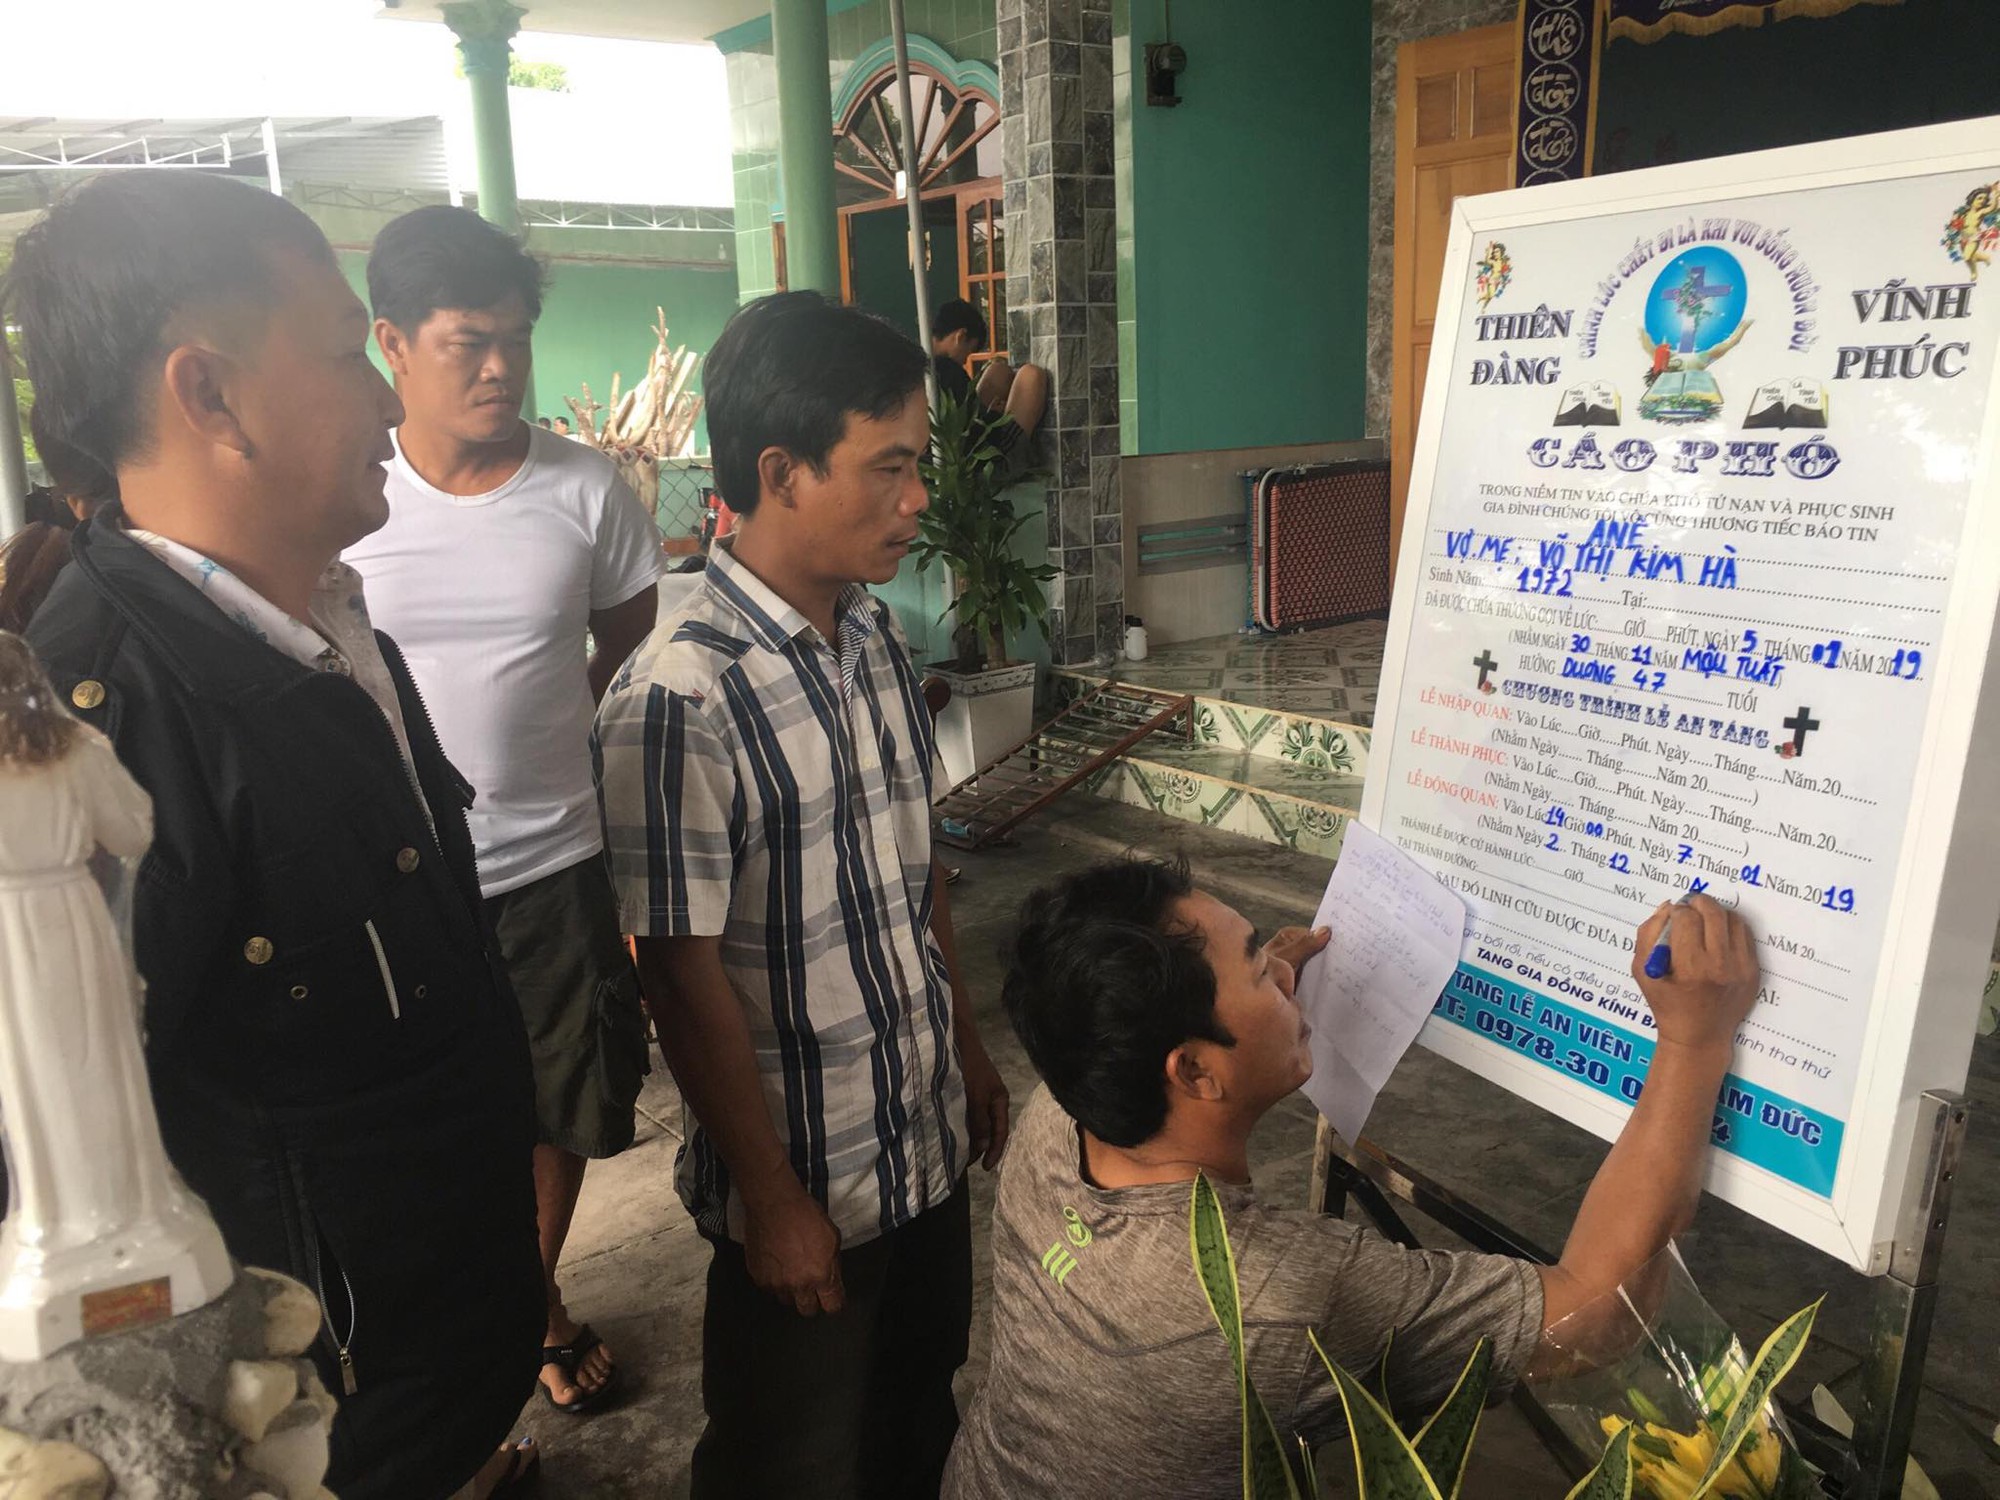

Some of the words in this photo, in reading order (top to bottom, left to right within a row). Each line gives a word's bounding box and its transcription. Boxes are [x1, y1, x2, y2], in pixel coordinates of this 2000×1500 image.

[1700, 218, 1731, 240] KHI
[1732, 218, 1761, 247] VUI
[1475, 303, 1575, 341] THIÊN
[1851, 277, 1977, 323] VĨNH
[1470, 350, 1561, 386] ĐÀNG
[1832, 333, 1970, 380] PHÚC
[1527, 432, 1658, 473] CÁO
[1671, 435, 1841, 480] PHÓ
[1479, 484, 1522, 498] TRONG
[1560, 488, 1584, 501] TIN
[1729, 498, 1765, 515] NẠN
[1770, 498, 1793, 514] VÀ
[1798, 501, 1846, 520] PHỤC
[1850, 504, 1895, 521] SINH
[1483, 501, 1506, 514] GIA
[1507, 502, 1540, 517] ĐÌNH
[1542, 504, 1590, 521] CHÚNG
[1763, 517, 1801, 536] TIẾC
[1804, 522, 1844, 540] BÁO
[1847, 527, 1879, 542] TIN
[1429, 566, 1453, 583] Sinh
[1517, 566, 1574, 598] 1972
[1573, 542, 1615, 582] THỊ
[1698, 544, 1737, 590] HÀ
[1570, 634, 1591, 653] 30
[1595, 641, 1629, 662] THÁNG
[1631, 644, 1652, 666] 11
[1702, 629, 1740, 653] NGÀY
[1764, 638, 1812, 665] THÁNG
[1841, 647, 1874, 674] NĂM
[1726, 686, 1758, 713] TUỔI
[1517, 709, 1538, 728] Vào
[1656, 740, 1690, 765] Ngày
[1713, 752, 1758, 781] Tháng
[1673, 712, 1704, 736] AN
[1708, 717, 1770, 749] TÁNG
[1529, 735, 1560, 757] Ngày
[1586, 748, 1624, 775] Tháng
[1656, 765, 1687, 787] Năm
[1513, 754, 1534, 773] Vào
[1650, 789, 1686, 815] Ngày
[1709, 803, 1752, 833] Tháng
[1522, 782, 1552, 805] Ngày
[1579, 795, 1616, 821] Tháng
[1647, 814, 1679, 836] Năm
[1503, 797, 1524, 817] Vào
[1640, 836, 1673, 863] Ngày
[1698, 852, 1740, 881] Tháng
[1545, 833, 1560, 852] 2
[1571, 841, 1607, 867] Tháng
[1608, 851, 1631, 875] 12
[1639, 862, 1670, 885] Năm
[1435, 870, 1460, 892] SAU
[1460, 880, 1480, 899] ĐÓ
[1481, 886, 1513, 908] LINH
[1545, 908, 1587, 936] ĐƯỢC
[1587, 923, 1619, 947] ĐƯA
[1766, 932, 1799, 956] NĂM
[1476, 947, 1514, 970] TANG
[1517, 963, 1542, 984] GIA
[1547, 974, 1595, 1002] ĐỒNG
[1597, 992, 1639, 1021] KÍNH
[1552, 960, 1571, 976] có
[1801, 1059, 1832, 1080] thứ
[1454, 970, 1504, 1008] TANG
[1508, 993, 1536, 1020] LỄ
[1539, 1007, 1572, 1037] AN
[1578, 1022, 1635, 1065] VIÊN
[1761, 1101, 1823, 1147] ĐỨC
